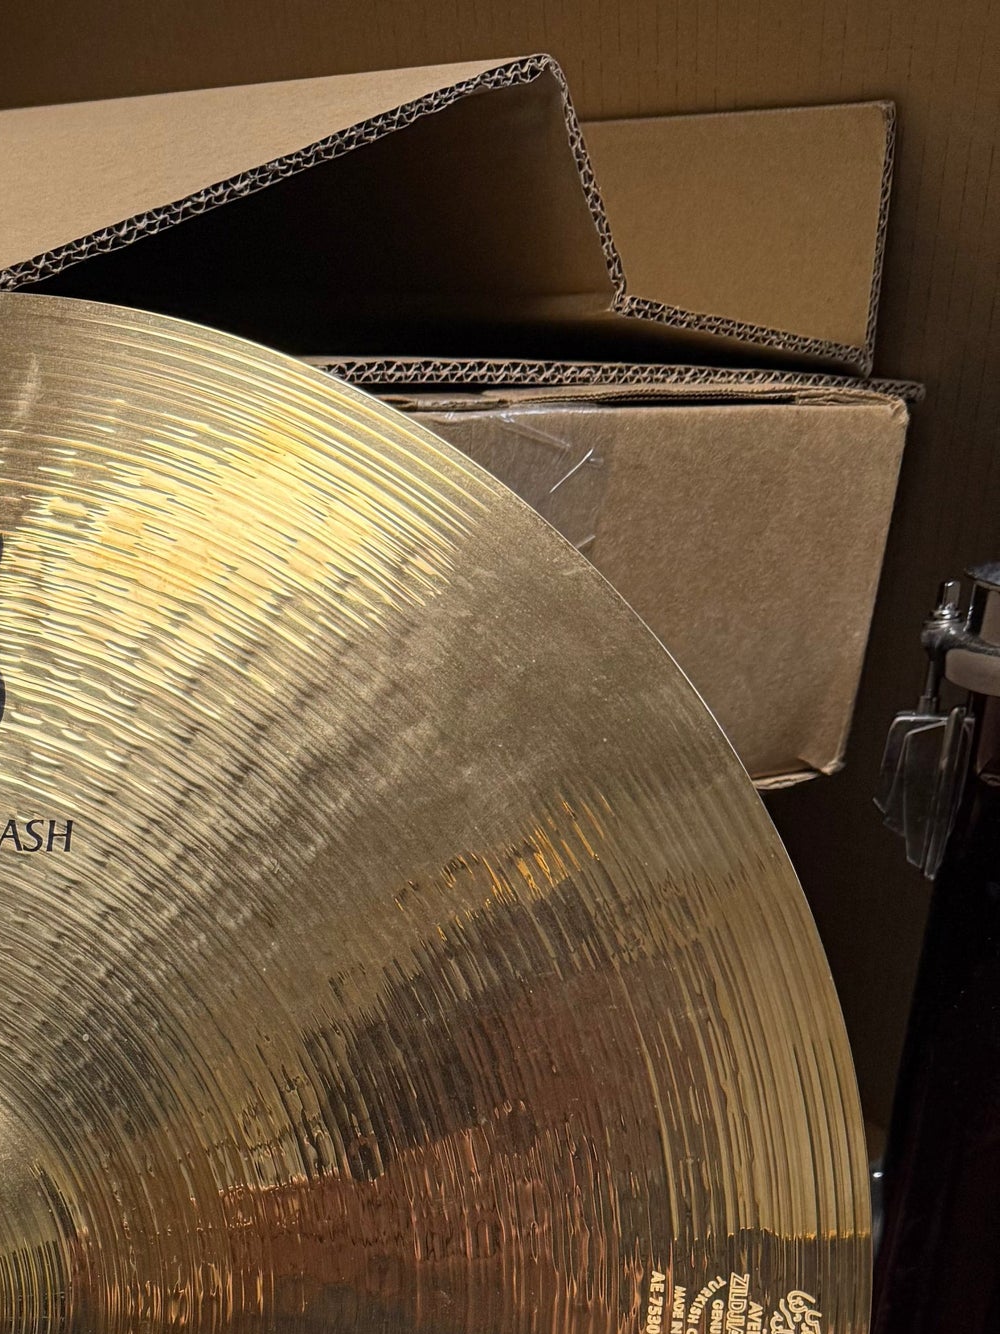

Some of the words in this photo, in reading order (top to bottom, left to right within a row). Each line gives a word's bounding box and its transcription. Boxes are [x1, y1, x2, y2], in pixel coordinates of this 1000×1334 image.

[650, 1270, 665, 1293] AE
[672, 1285, 686, 1318] MADE
[687, 1275, 727, 1324] TURKISH
[671, 1320, 683, 1334] IN
